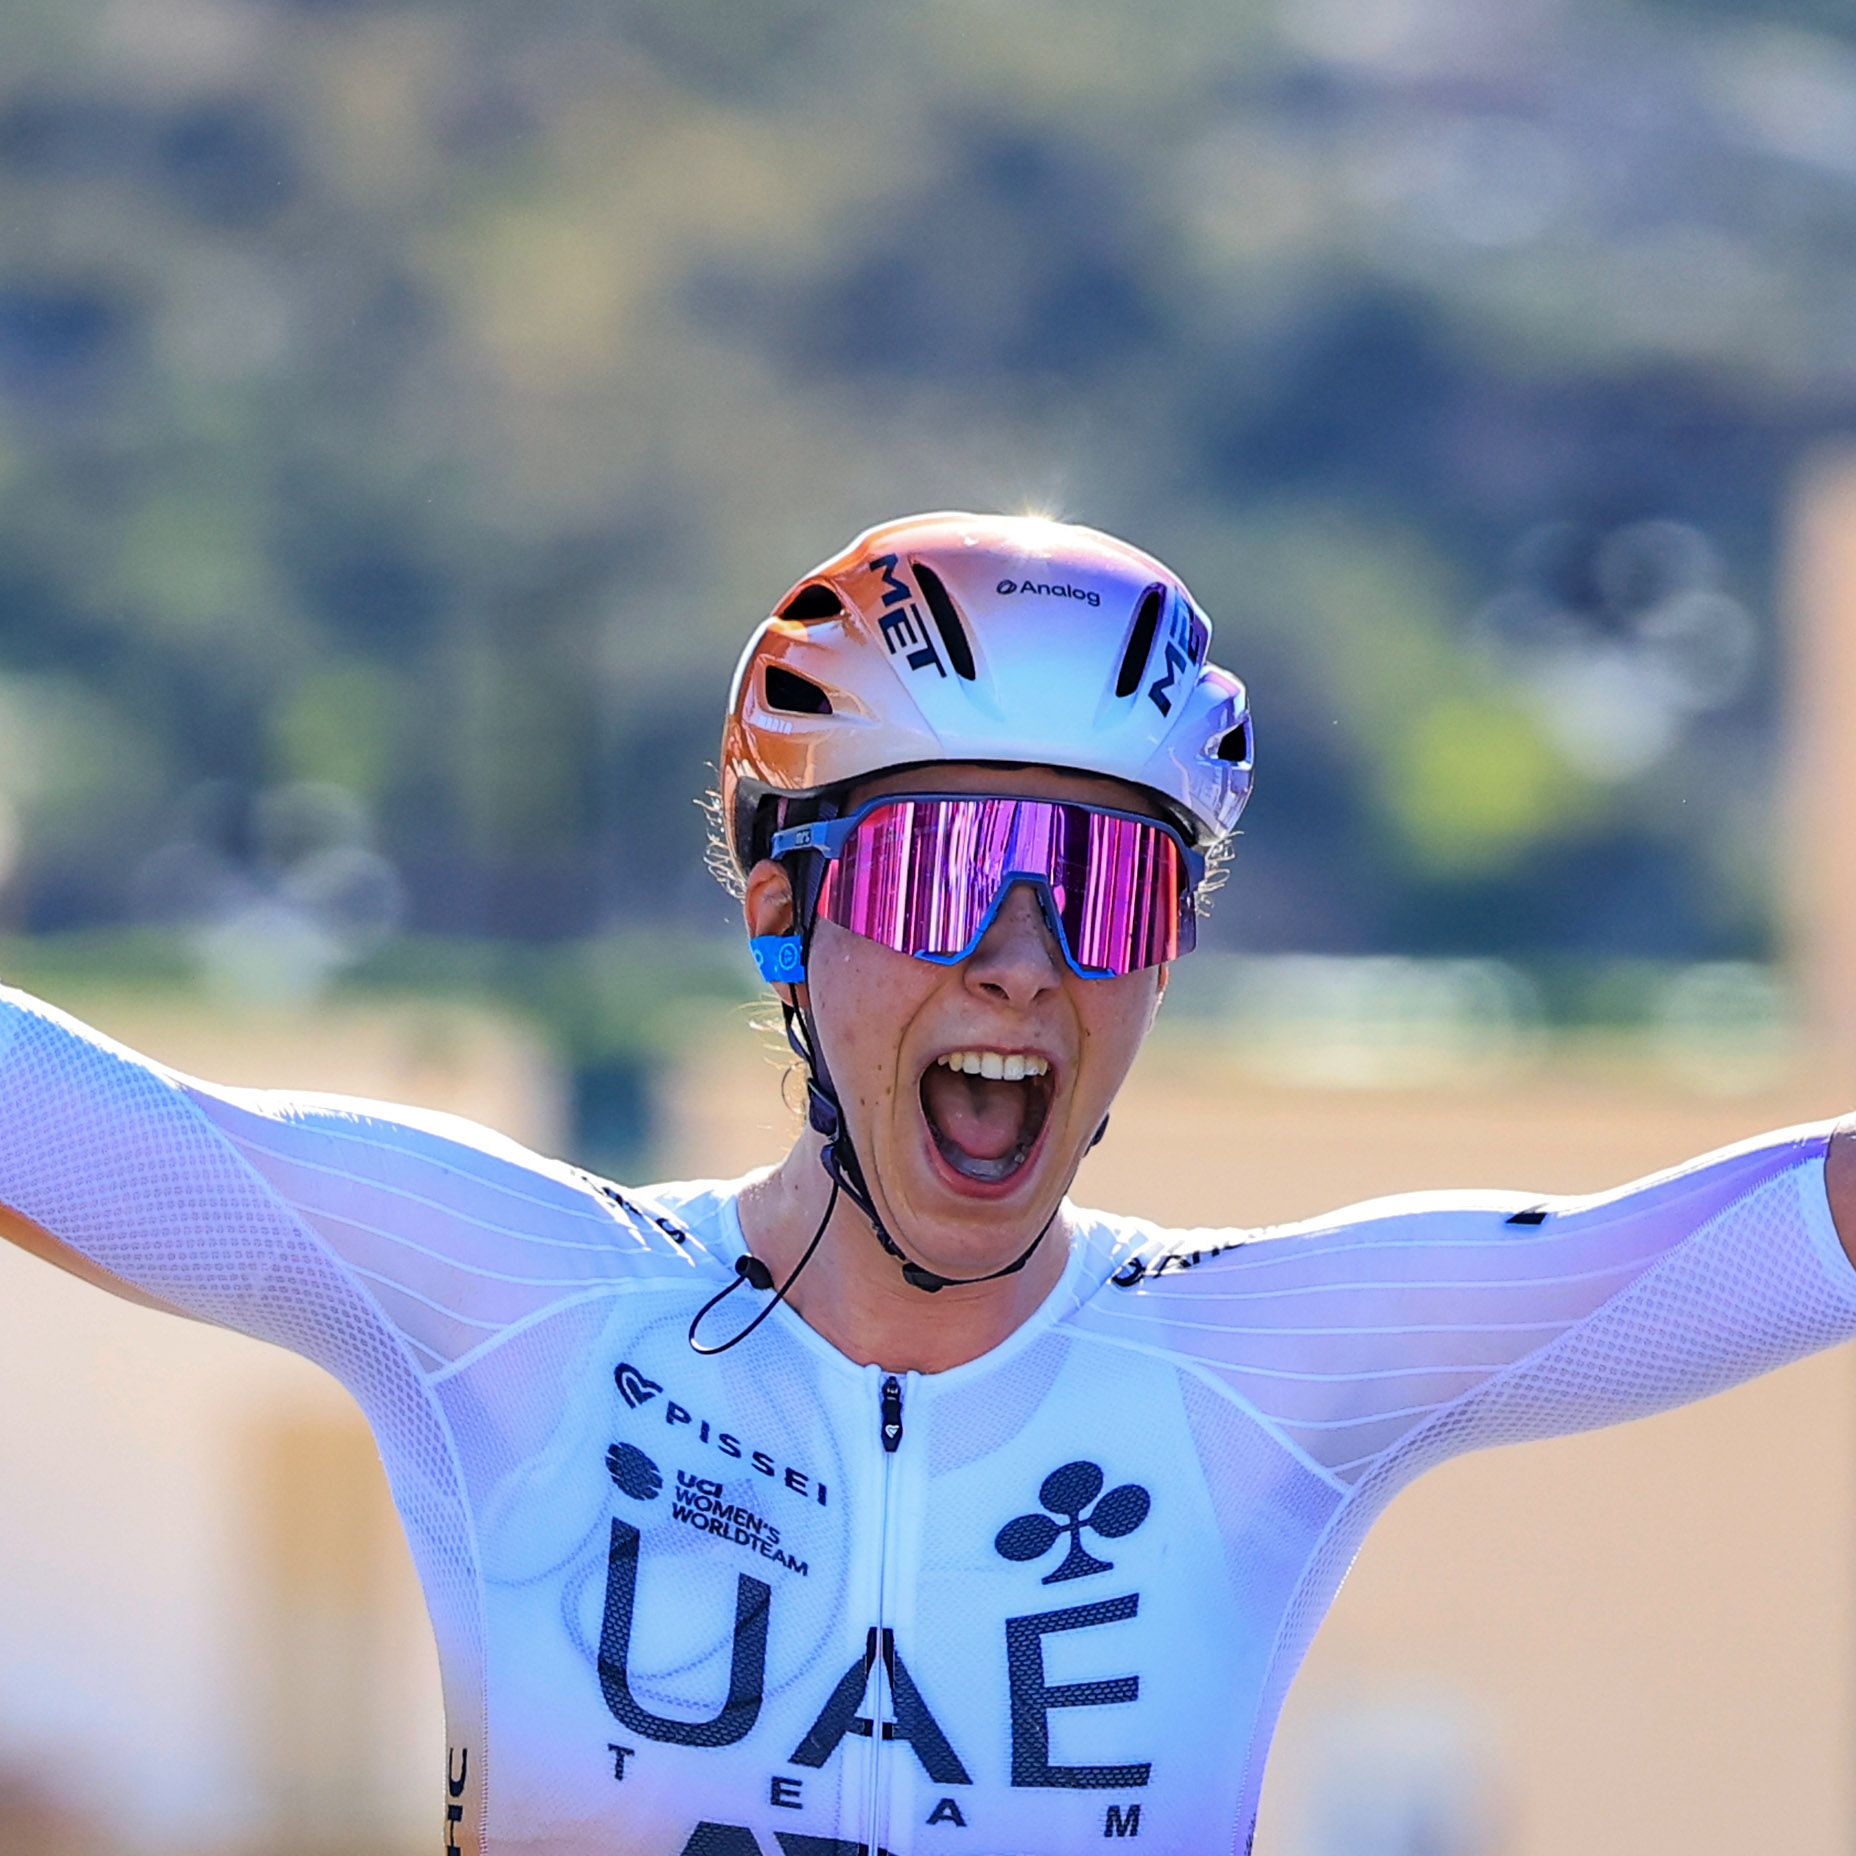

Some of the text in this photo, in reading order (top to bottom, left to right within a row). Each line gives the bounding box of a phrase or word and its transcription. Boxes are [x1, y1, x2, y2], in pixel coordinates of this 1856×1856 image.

[869, 553, 947, 678] MET
[1020, 581, 1101, 607] Analog
[665, 1400, 827, 1506] PISSEI
[676, 1469, 724, 1499] UCI
[671, 1502, 809, 1577] WORLDTEAM
[675, 1485, 781, 1545] WOMEN'S
[597, 1516, 1152, 1790] UAE
[607, 1743, 1142, 1838] TEAM
